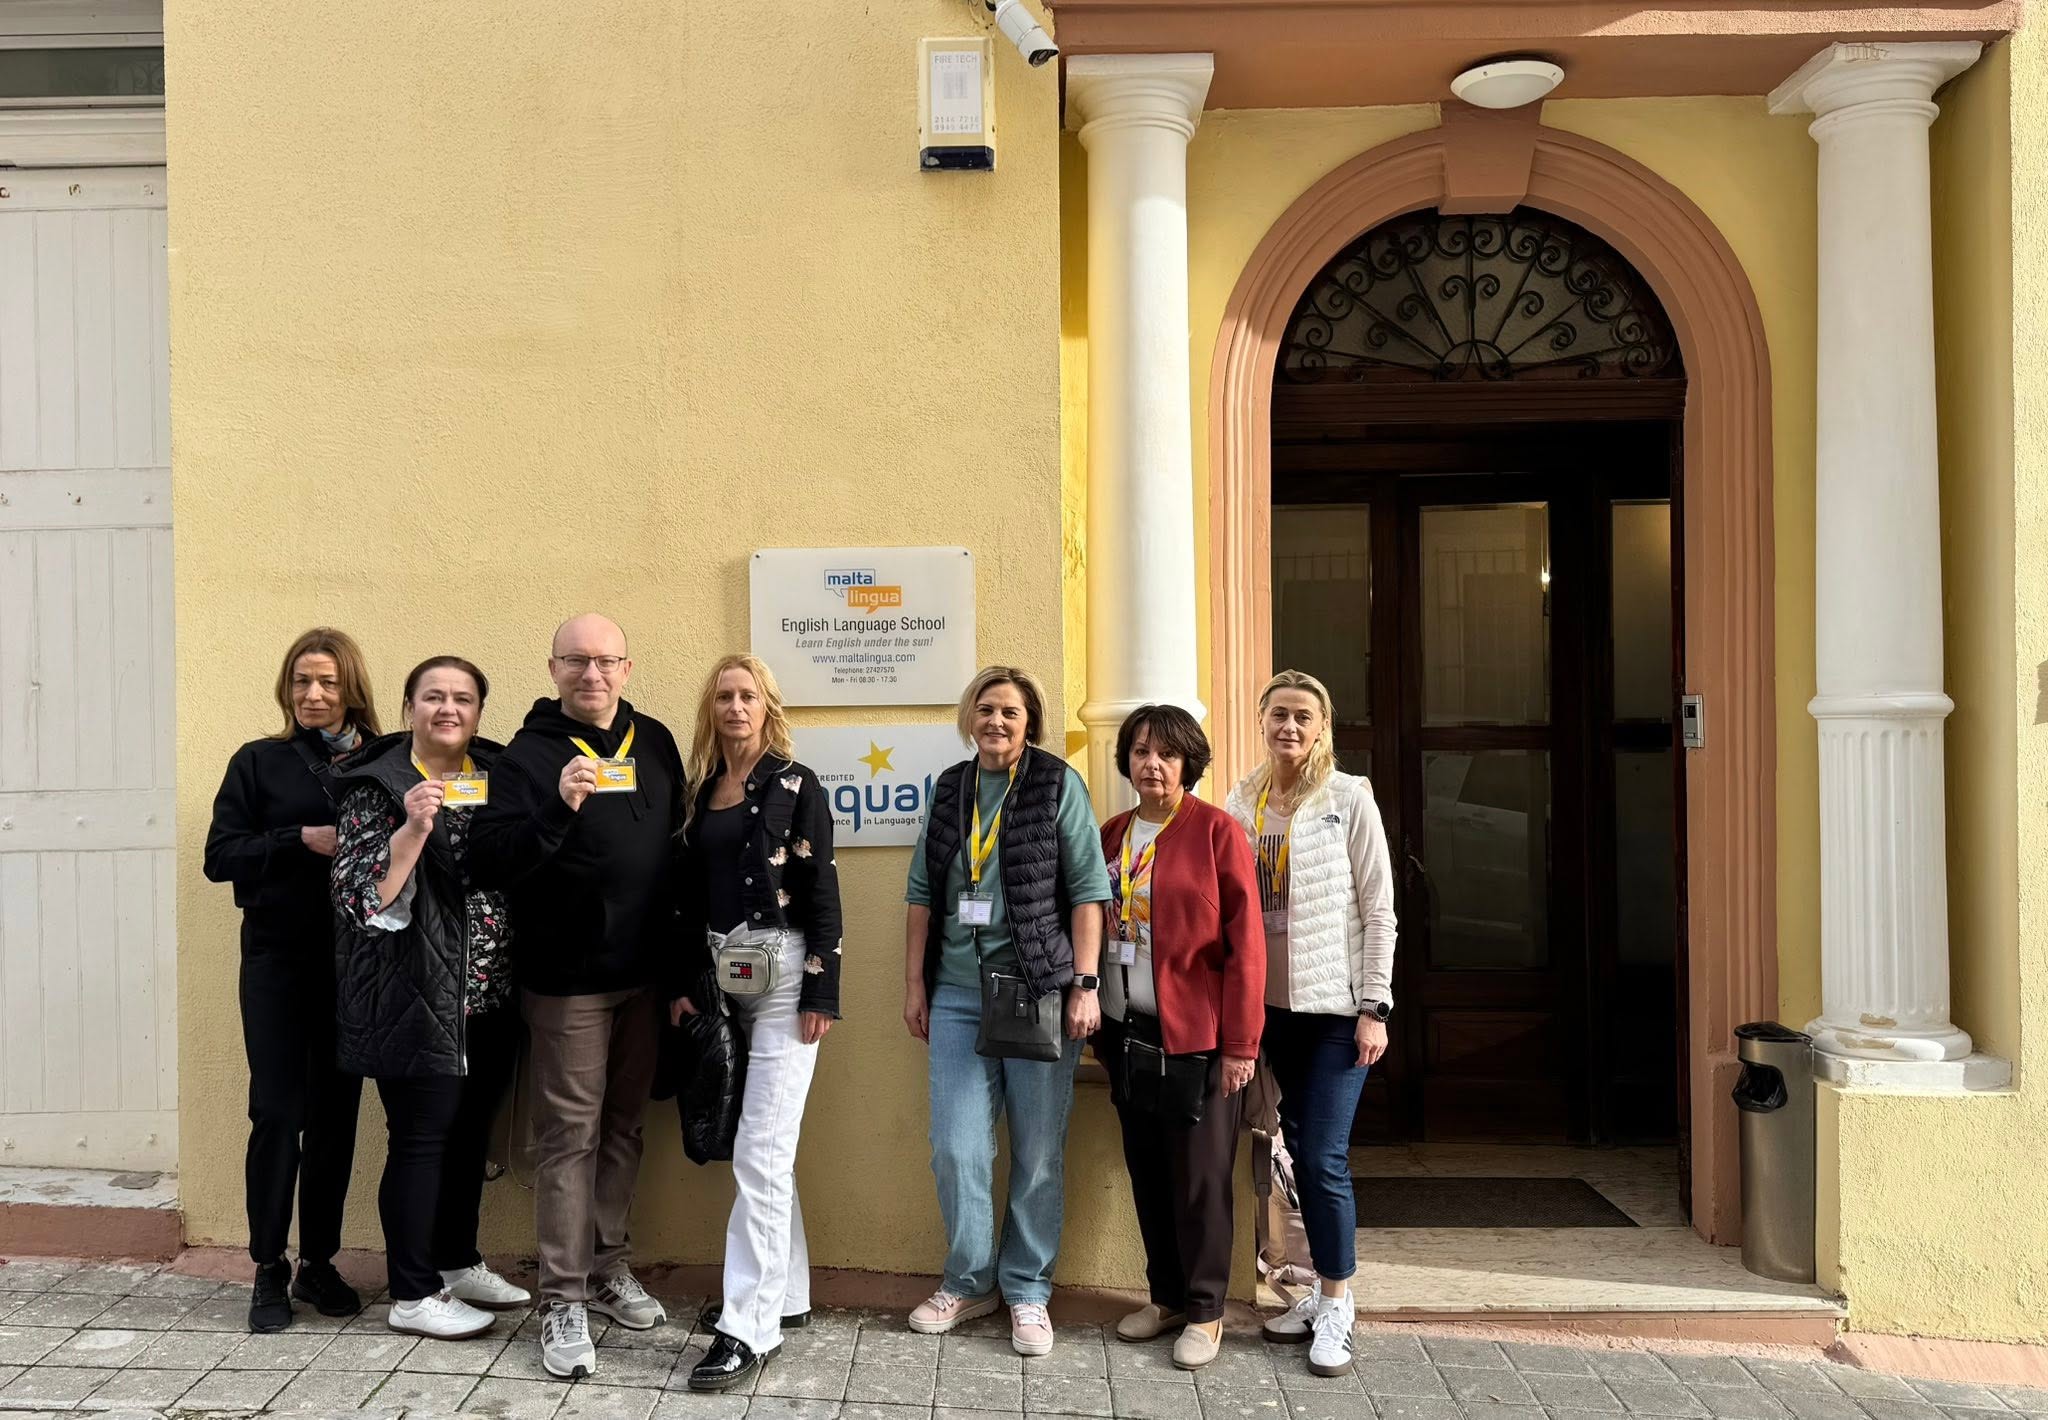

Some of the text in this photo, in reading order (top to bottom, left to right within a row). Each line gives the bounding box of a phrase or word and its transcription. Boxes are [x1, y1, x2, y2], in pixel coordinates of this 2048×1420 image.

[934, 54, 977, 64] FIRE TECH
[827, 572, 873, 585] malta
[850, 590, 900, 606] lingua
[781, 616, 945, 635] English Language School
[795, 636, 934, 650] Learn English under the sun!
[812, 652, 916, 665] www.maltalingua.com
[834, 666, 864, 674] Telephone:
[833, 818, 851, 826] nce
[864, 817, 872, 825] in
[874, 816, 916, 827] Language
